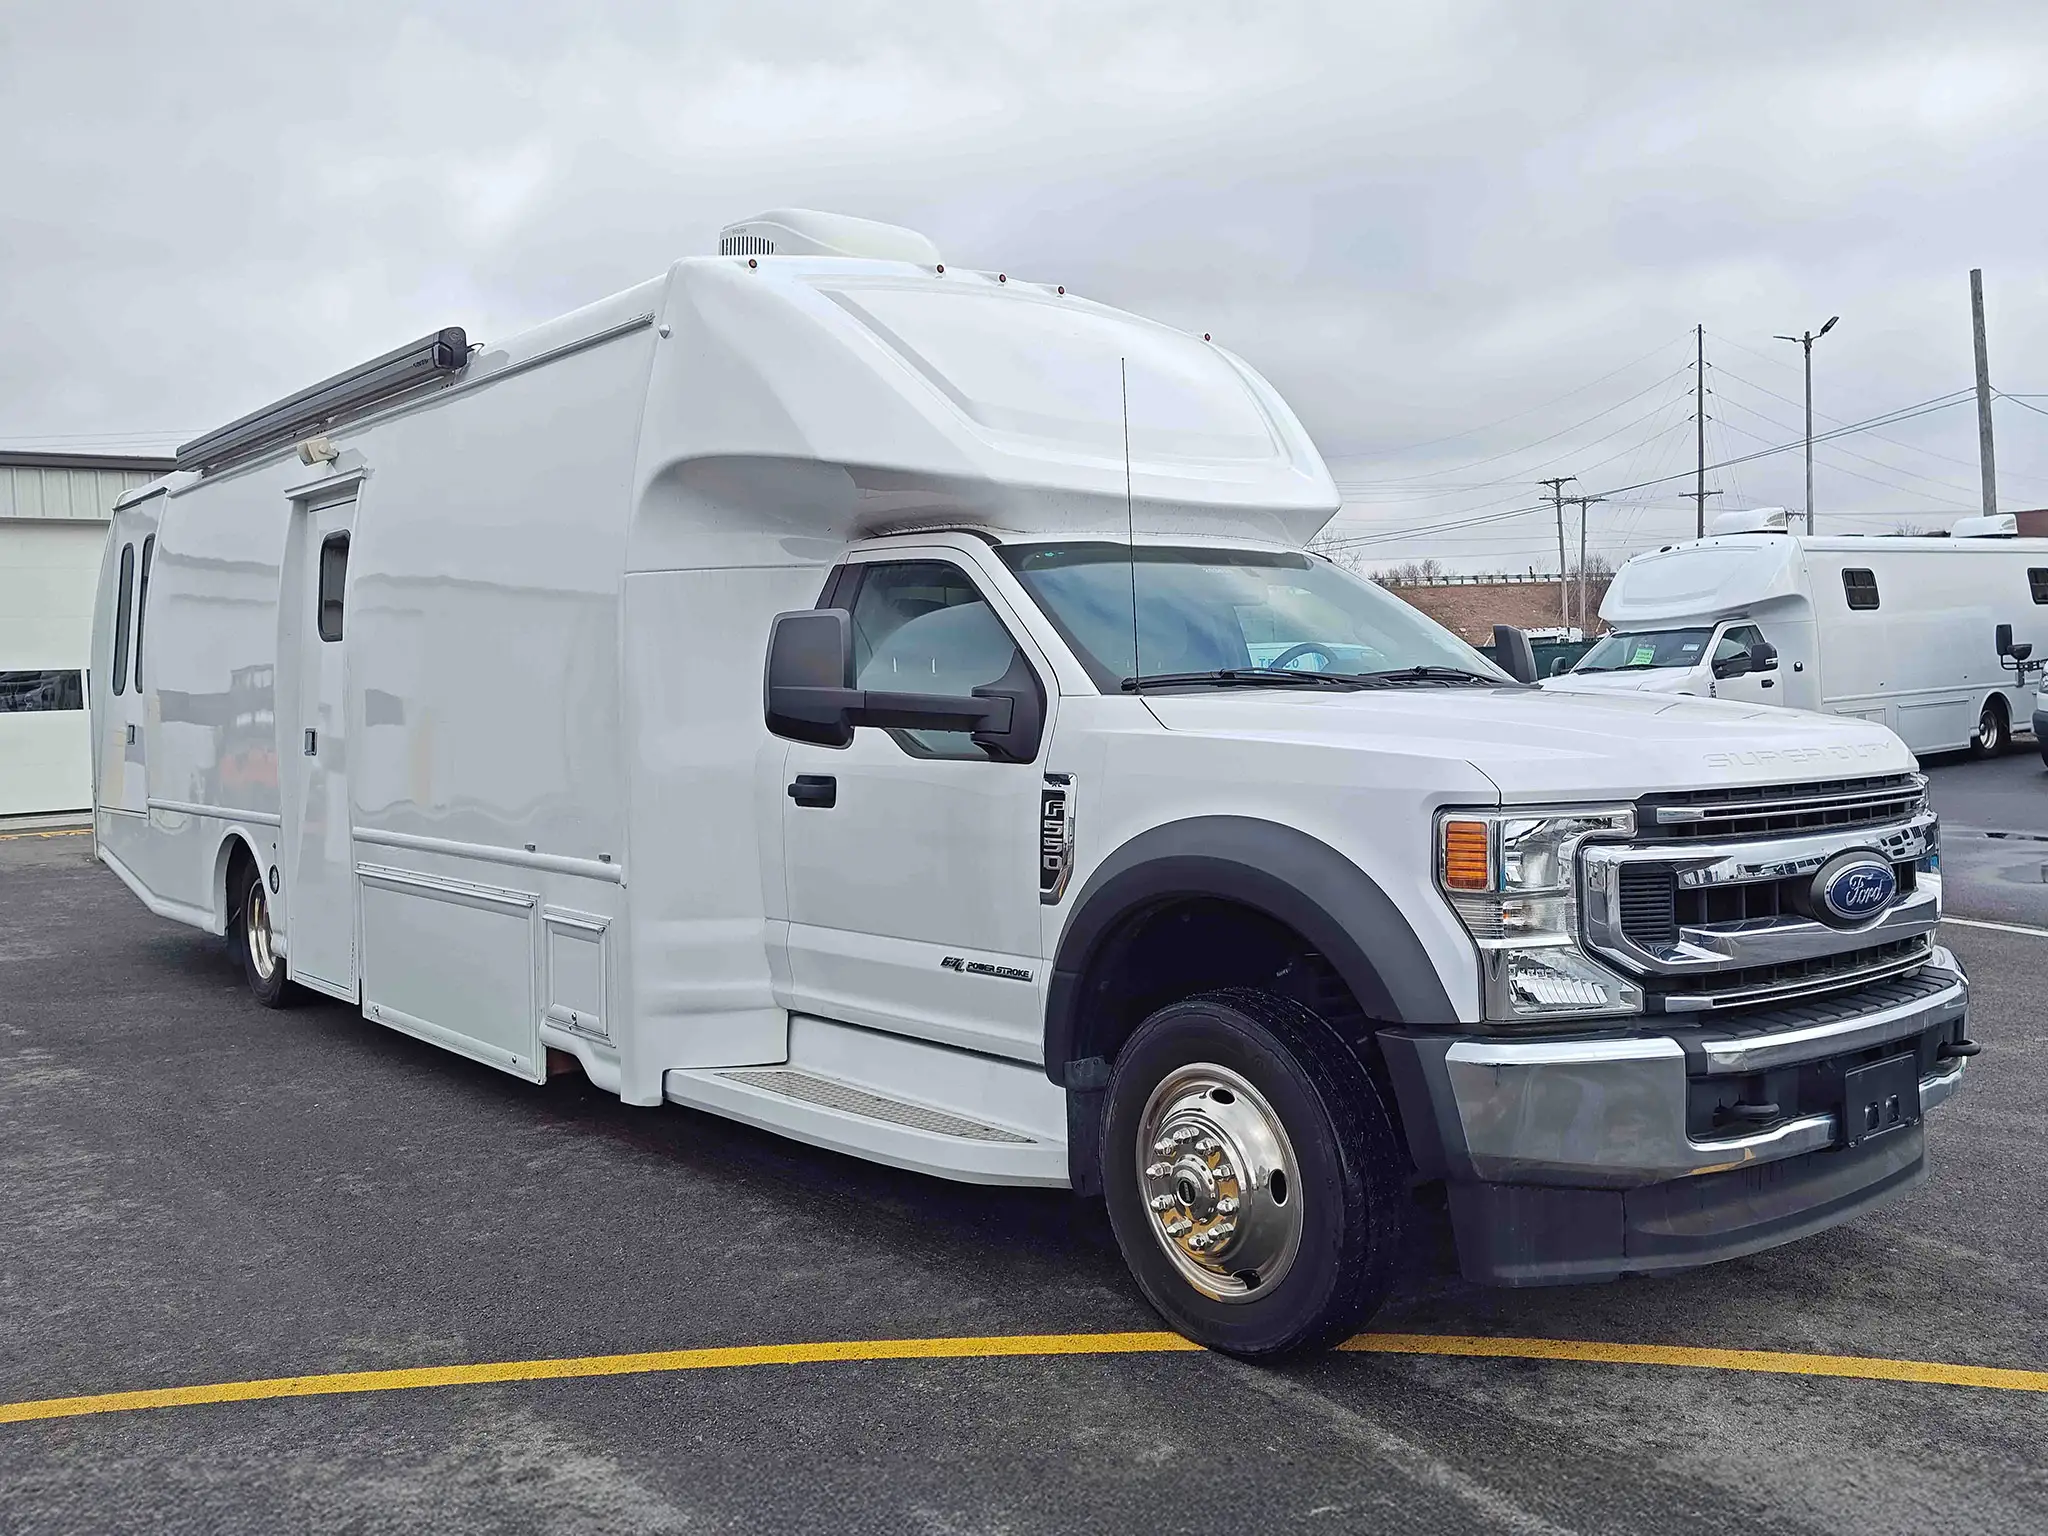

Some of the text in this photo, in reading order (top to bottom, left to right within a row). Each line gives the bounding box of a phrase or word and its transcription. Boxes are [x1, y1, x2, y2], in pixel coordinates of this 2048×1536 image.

[1846, 873, 1884, 906] Ford
[967, 962, 995, 972] POWER
[996, 966, 1030, 978] STROKE
